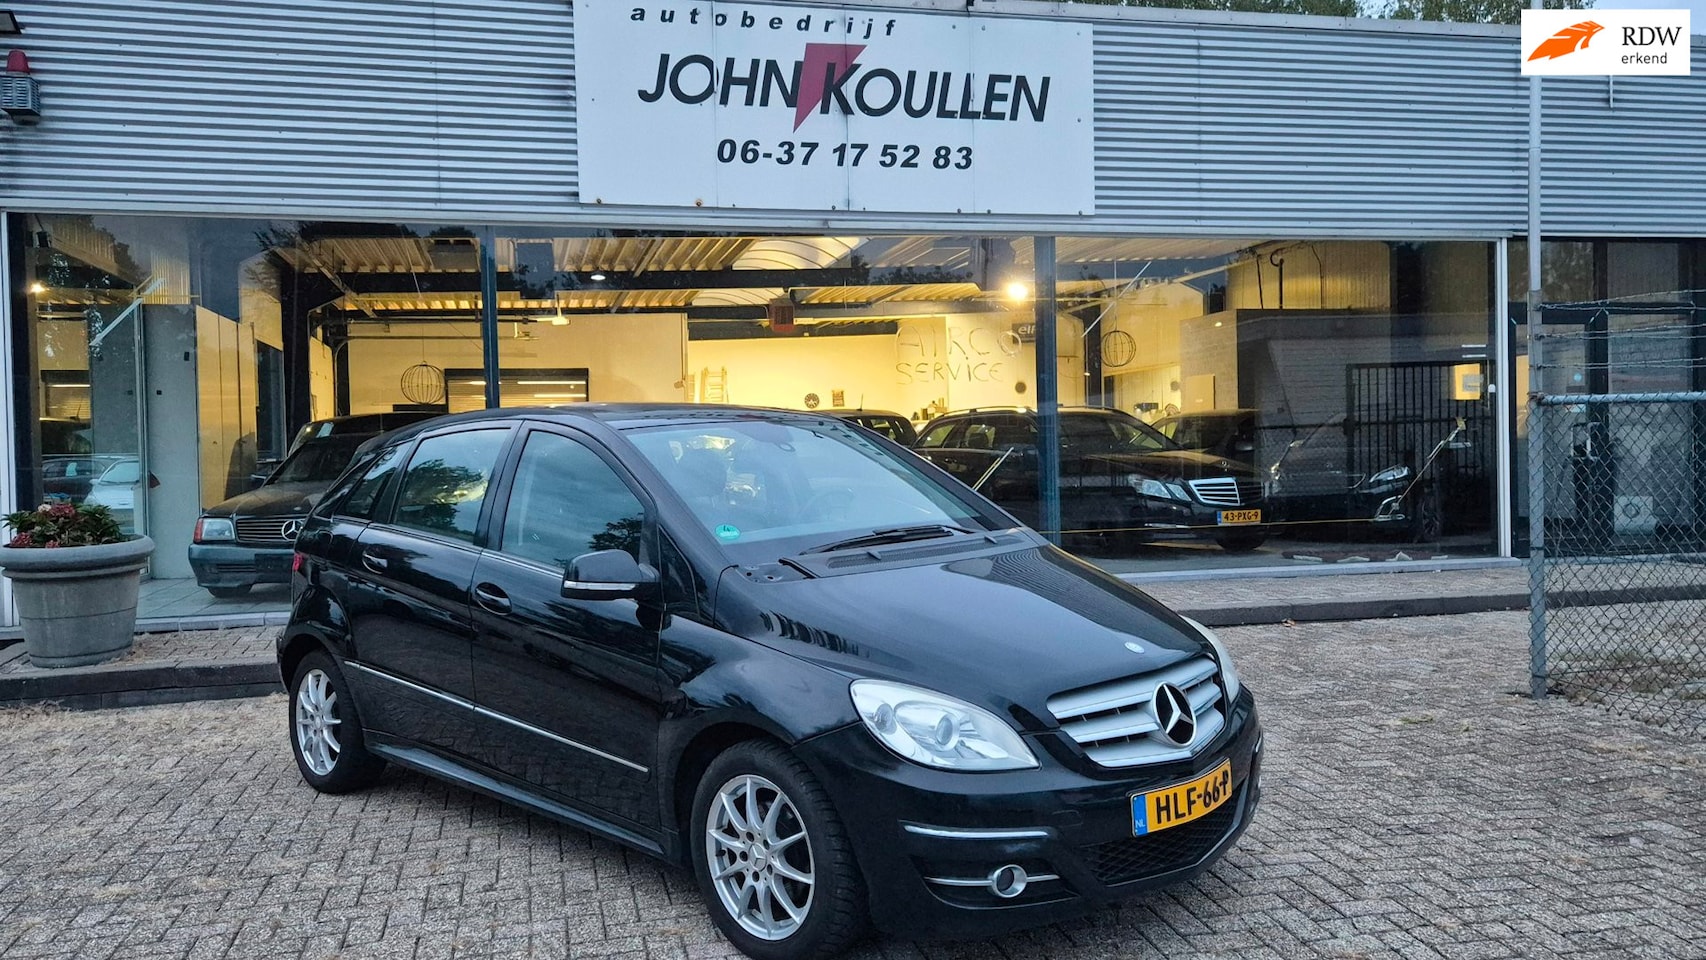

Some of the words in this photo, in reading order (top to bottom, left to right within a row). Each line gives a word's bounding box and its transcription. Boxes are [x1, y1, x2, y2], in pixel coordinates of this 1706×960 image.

[630, 7, 896, 39] autobedrijf
[637, 53, 804, 108] JOHN
[820, 62, 1051, 122] KOULLEN
[717, 138, 819, 166] 06-37
[831, 143, 869, 167] 17
[879, 146, 920, 169] 52
[932, 146, 974, 170] 83
[895, 325, 1022, 357] AIRCO
[895, 362, 1004, 384] SERVICE
[1224, 511, 1259, 521] 43-PXG-9
[1155, 769, 1229, 824] HLF-66-P
[1135, 819, 1146, 829] NL
